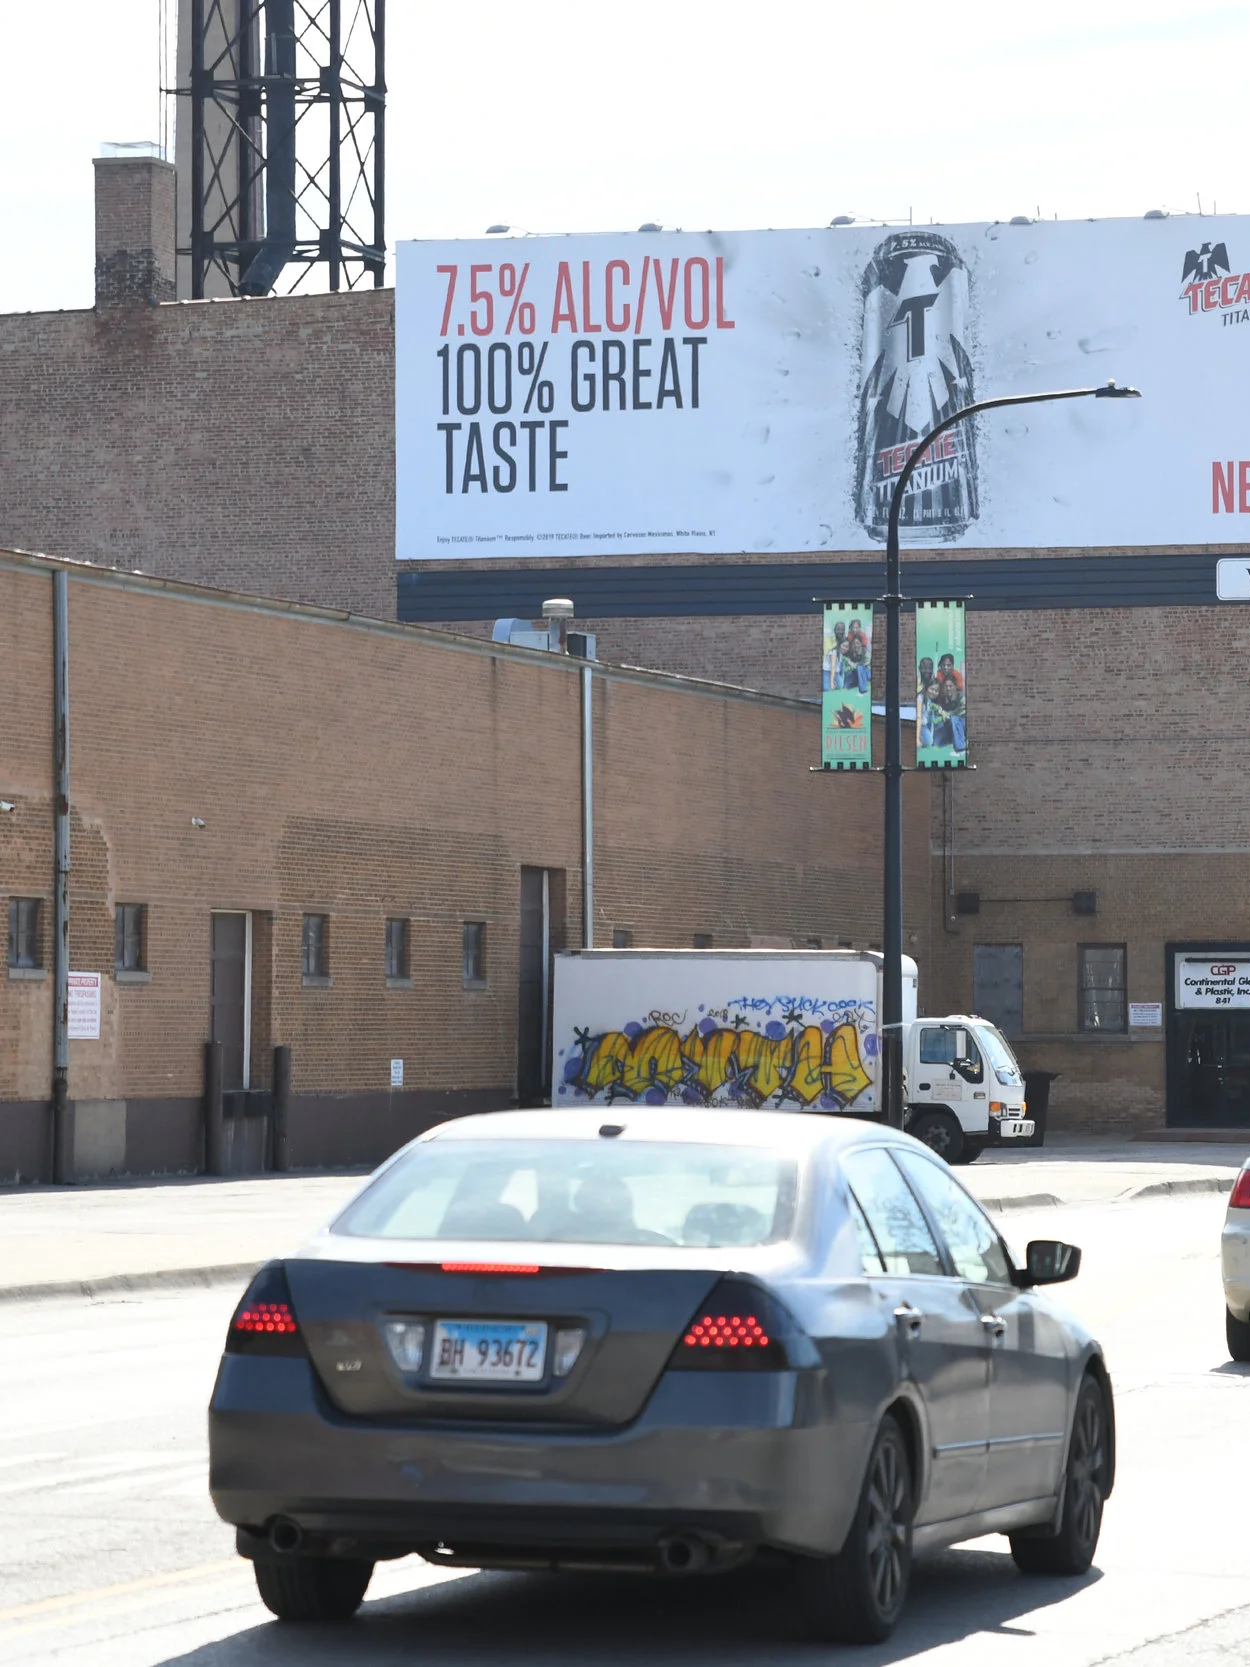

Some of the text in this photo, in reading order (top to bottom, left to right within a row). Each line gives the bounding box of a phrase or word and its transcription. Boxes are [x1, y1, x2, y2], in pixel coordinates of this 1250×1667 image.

[436, 255, 736, 337] 7.5% ALC/VOL
[436, 337, 708, 416] 100% GREAT
[436, 419, 569, 495] TASTE
[825, 735, 868, 752] PILSEN
[1210, 964, 1236, 976] CGP
[1184, 977, 1236, 987] Continental
[1195, 988, 1203, 996] &
[1205, 987, 1236, 997] Plastic,
[439, 1338, 540, 1368] BH 93672
